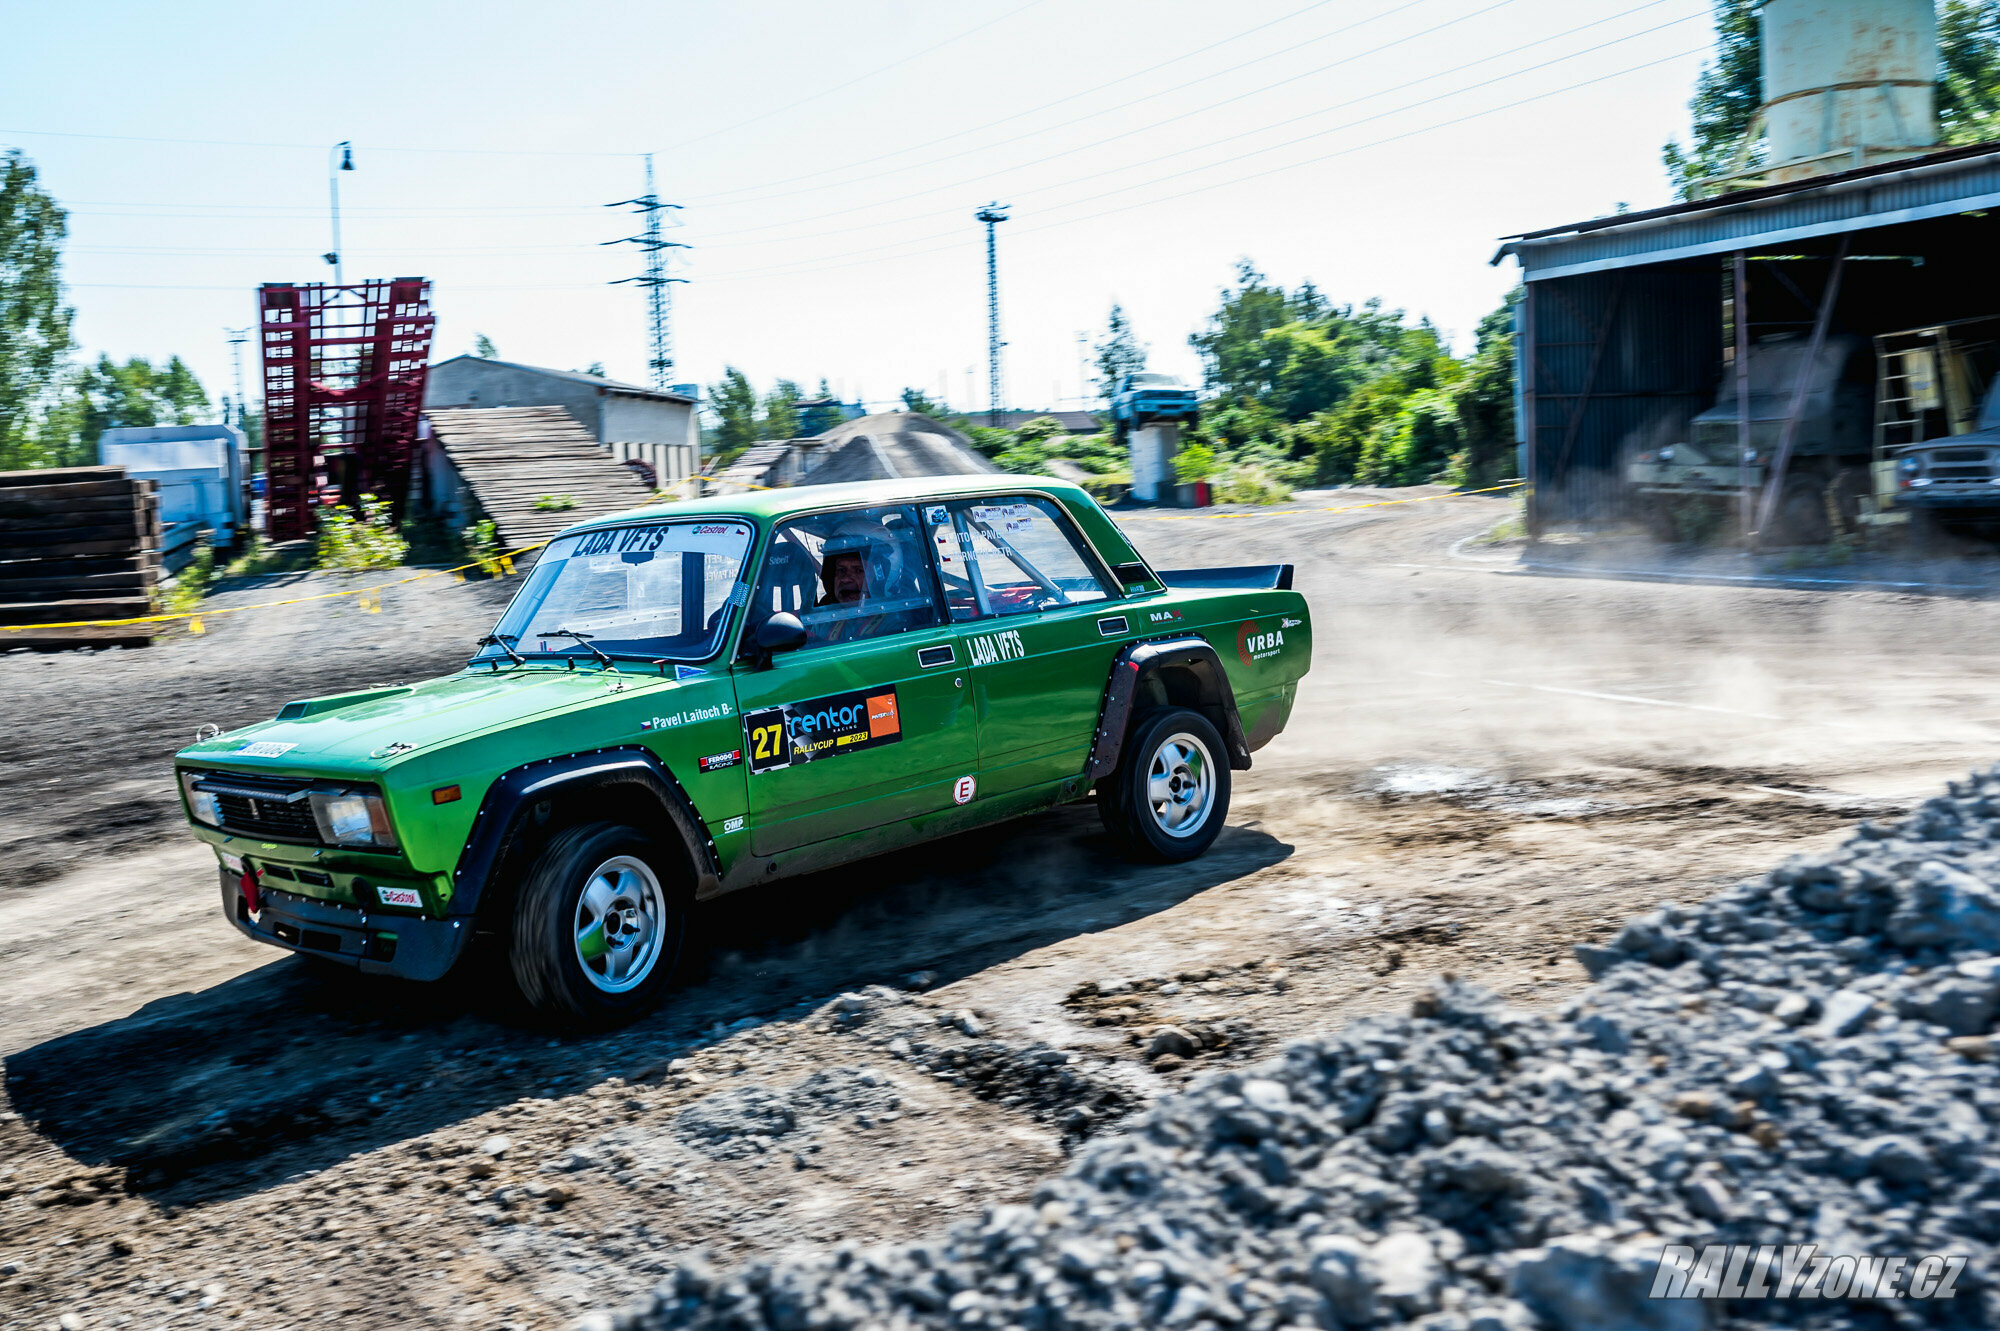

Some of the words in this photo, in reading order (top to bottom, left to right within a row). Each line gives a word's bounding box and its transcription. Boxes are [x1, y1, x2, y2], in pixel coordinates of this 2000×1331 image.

[571, 529, 619, 557] LADA
[617, 526, 669, 552] VFTS
[699, 525, 729, 535] Castrol
[966, 638, 1000, 666] LADA
[993, 629, 1025, 660] VFTS
[1247, 630, 1284, 653] VRBA
[1253, 648, 1281, 660] motorsport
[652, 713, 682, 730] Pavel
[683, 705, 720, 723] Laitoch
[790, 704, 864, 737] rentor
[833, 725, 858, 733] RACING
[752, 723, 782, 760] 27
[793, 739, 835, 755] RALLYCUP
[849, 732, 868, 743] 2023
[708, 753, 733, 764] FERODO
[960, 780, 970, 798] E
[724, 818, 744, 831] OMP
